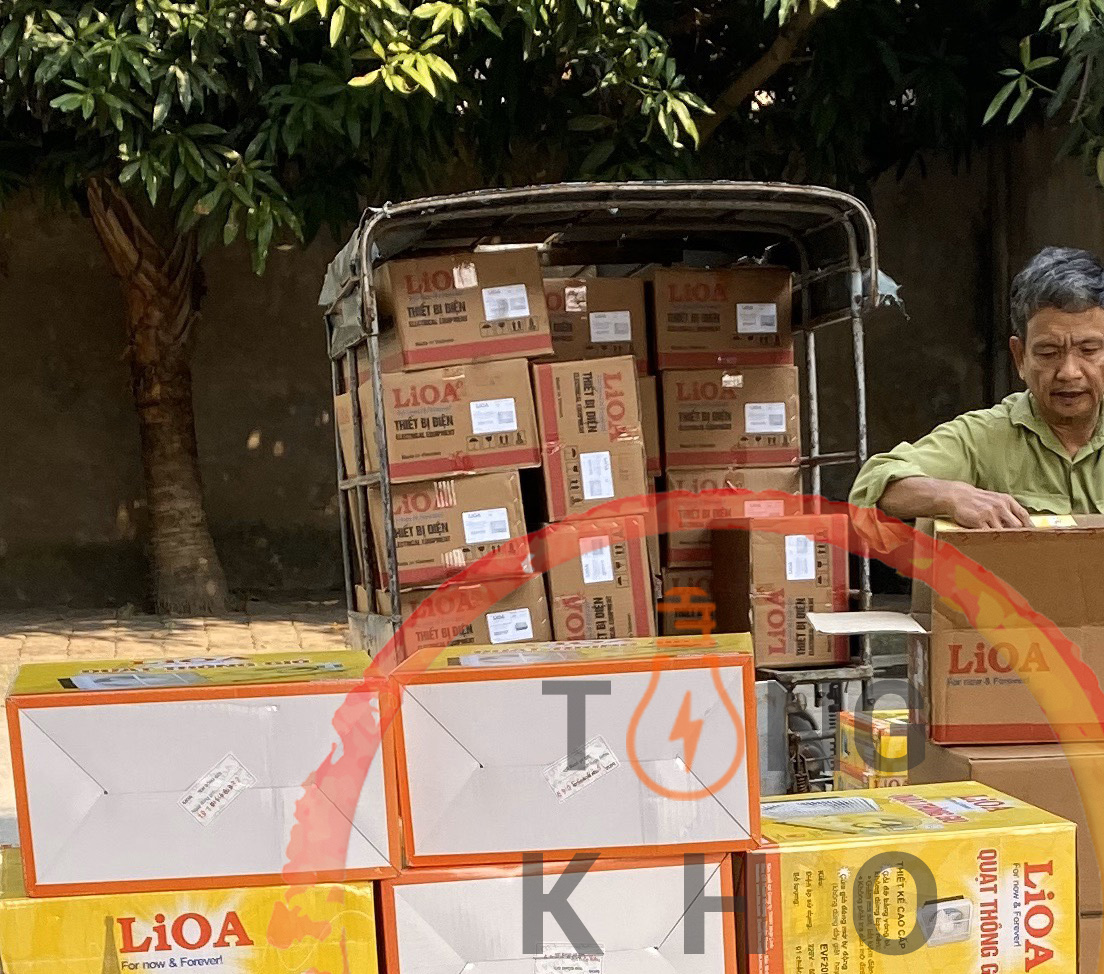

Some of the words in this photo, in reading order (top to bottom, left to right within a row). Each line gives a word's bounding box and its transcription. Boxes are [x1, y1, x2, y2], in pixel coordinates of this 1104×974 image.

[392, 382, 460, 408] LiOA
[603, 372, 626, 443] LiOA
[948, 642, 1050, 674] LiOA
[974, 849, 997, 894] QUẠT
[117, 911, 253, 953] LiOA
[897, 906, 905, 927] CAO
[980, 900, 1003, 960] THÔNG
[1023, 860, 1054, 973] LiOA
[121, 961, 140, 970] For
[143, 961, 166, 970] now
[169, 958, 177, 968] &
[180, 955, 223, 967] Forever!
